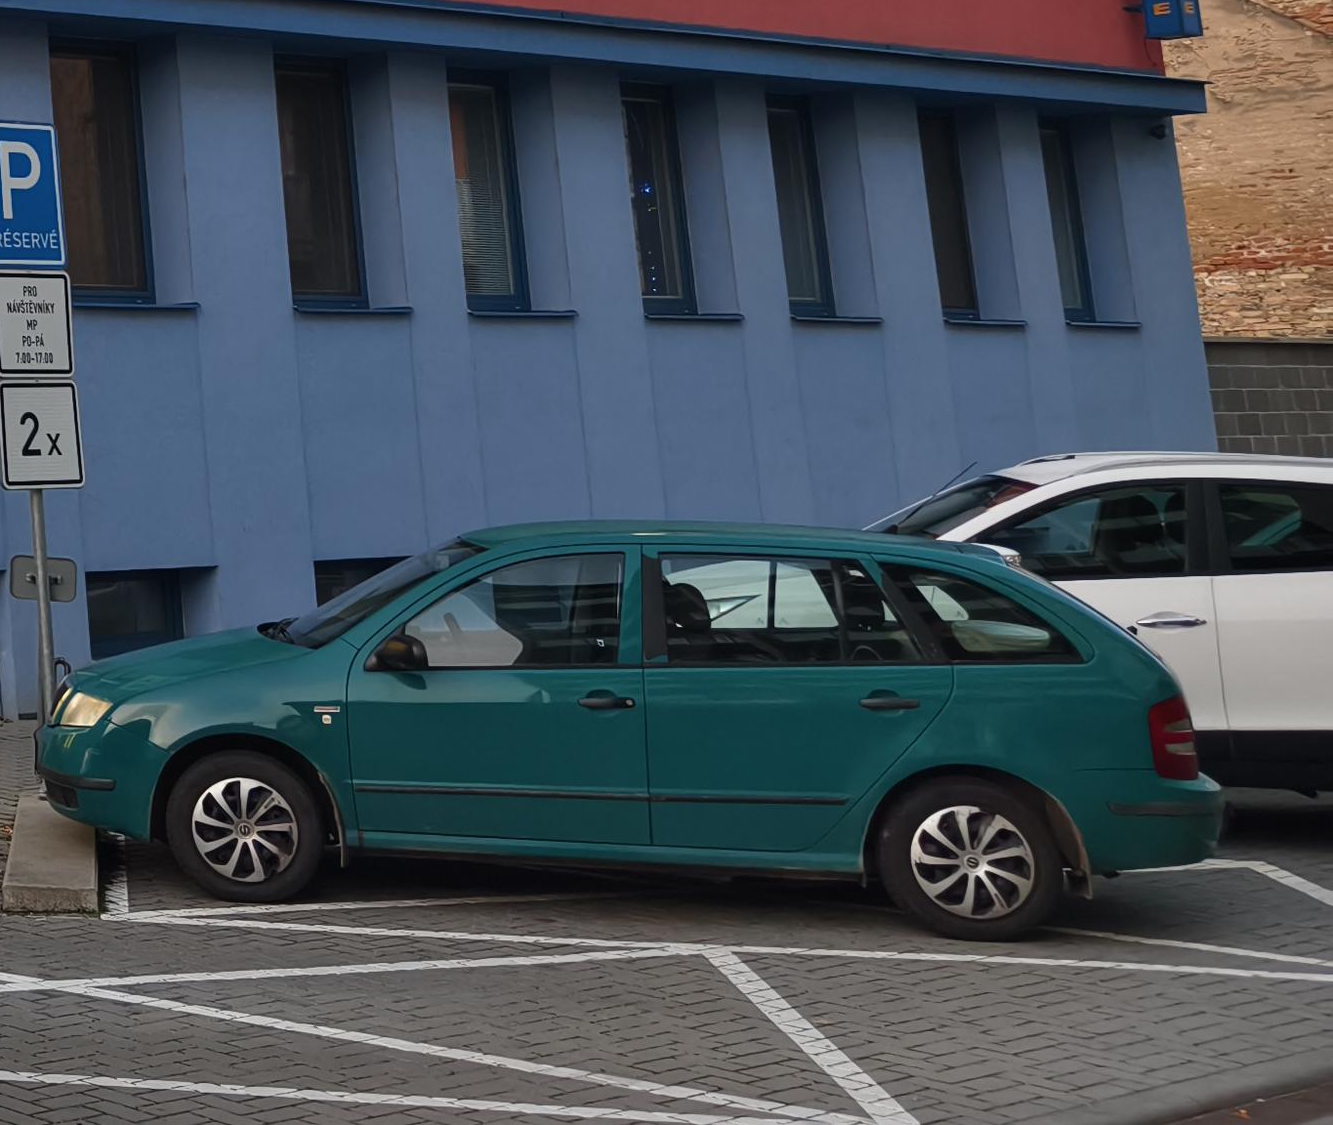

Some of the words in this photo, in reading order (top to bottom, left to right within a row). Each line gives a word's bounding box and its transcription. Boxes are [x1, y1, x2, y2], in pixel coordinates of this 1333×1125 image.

[0, 140, 41, 220] P
[22, 286, 37, 297] PRO
[6, 300, 55, 315] NÁVŠTĚVNÍKY
[26, 319, 38, 331] MP
[22, 333, 44, 347] PO-PÁ
